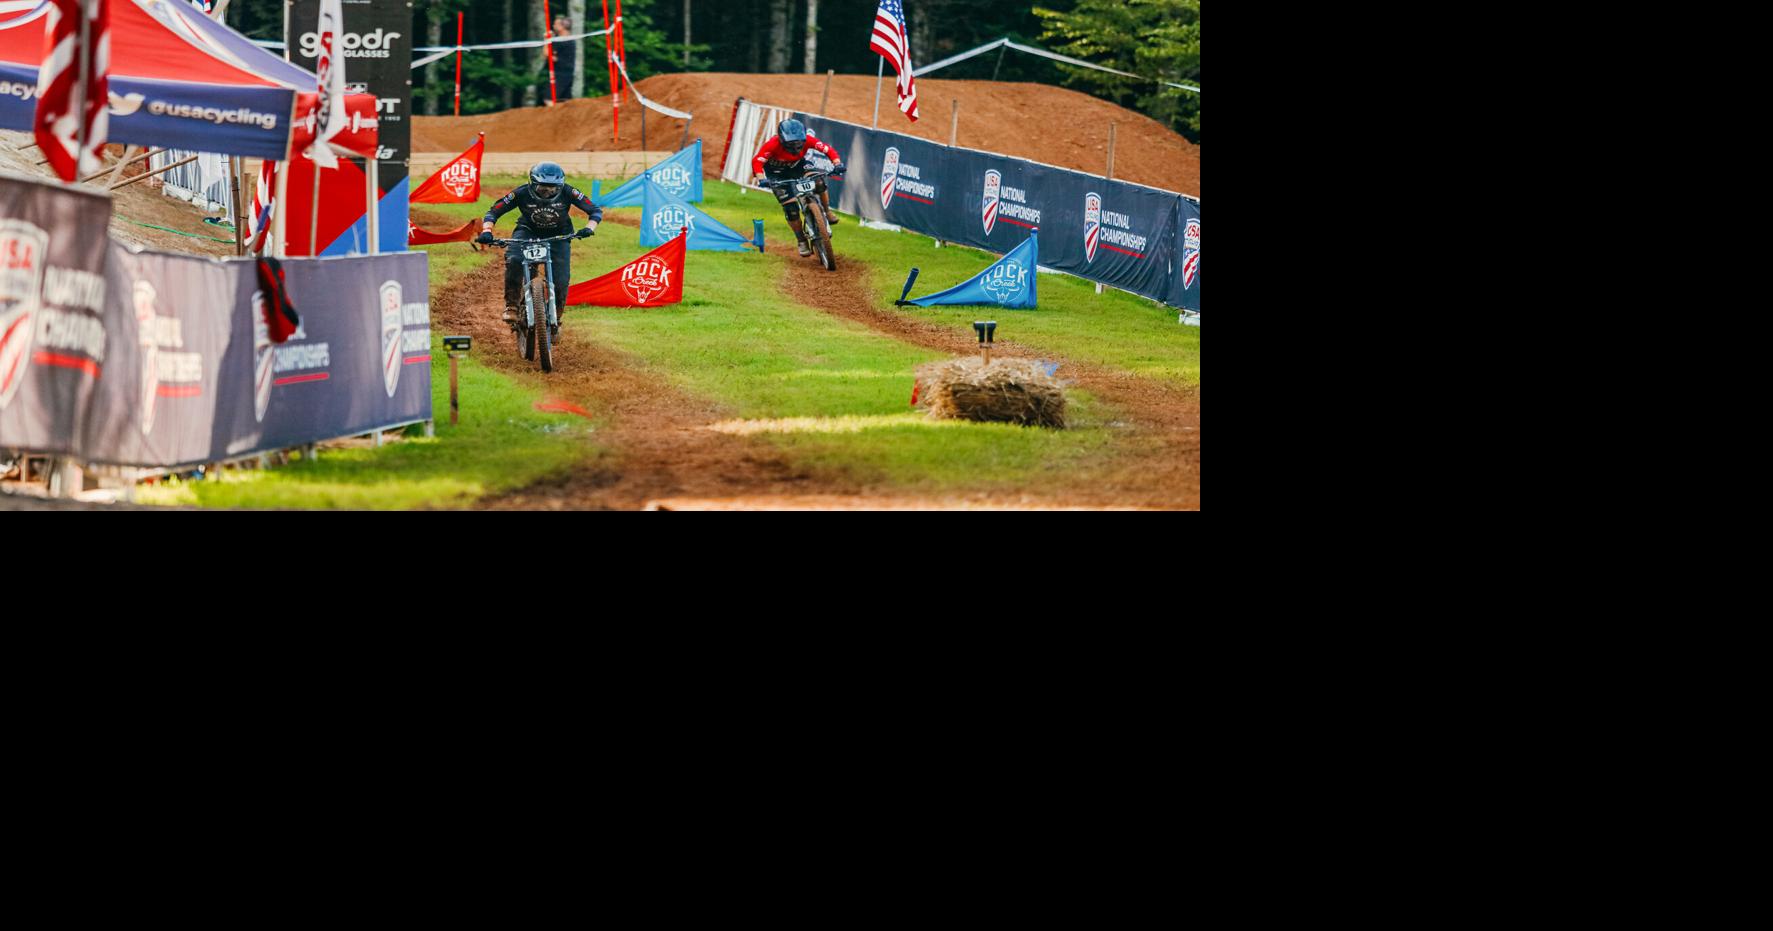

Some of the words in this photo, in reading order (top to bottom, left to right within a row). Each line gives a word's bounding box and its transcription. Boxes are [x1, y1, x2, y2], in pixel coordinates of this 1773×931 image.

[300, 28, 401, 58] godr
[148, 100, 277, 130] @usacycling
[652, 168, 691, 186] ROCK
[898, 162, 920, 180] NATIONAL
[802, 183, 811, 191] 10
[895, 177, 934, 199] CHAMPIONSHIPS
[1000, 185, 1026, 204] NATIONAL
[998, 201, 1041, 224] CHAMPIONSHIPS
[1088, 198, 1099, 211] USA
[653, 209, 695, 230] ROCK
[1101, 210, 1130, 230] NATIONAL
[1100, 227, 1147, 251] CHAMPIONSHIPS
[1187, 225, 1200, 240] USA
[527, 249, 541, 258] 12
[621, 261, 672, 287] ROCK
